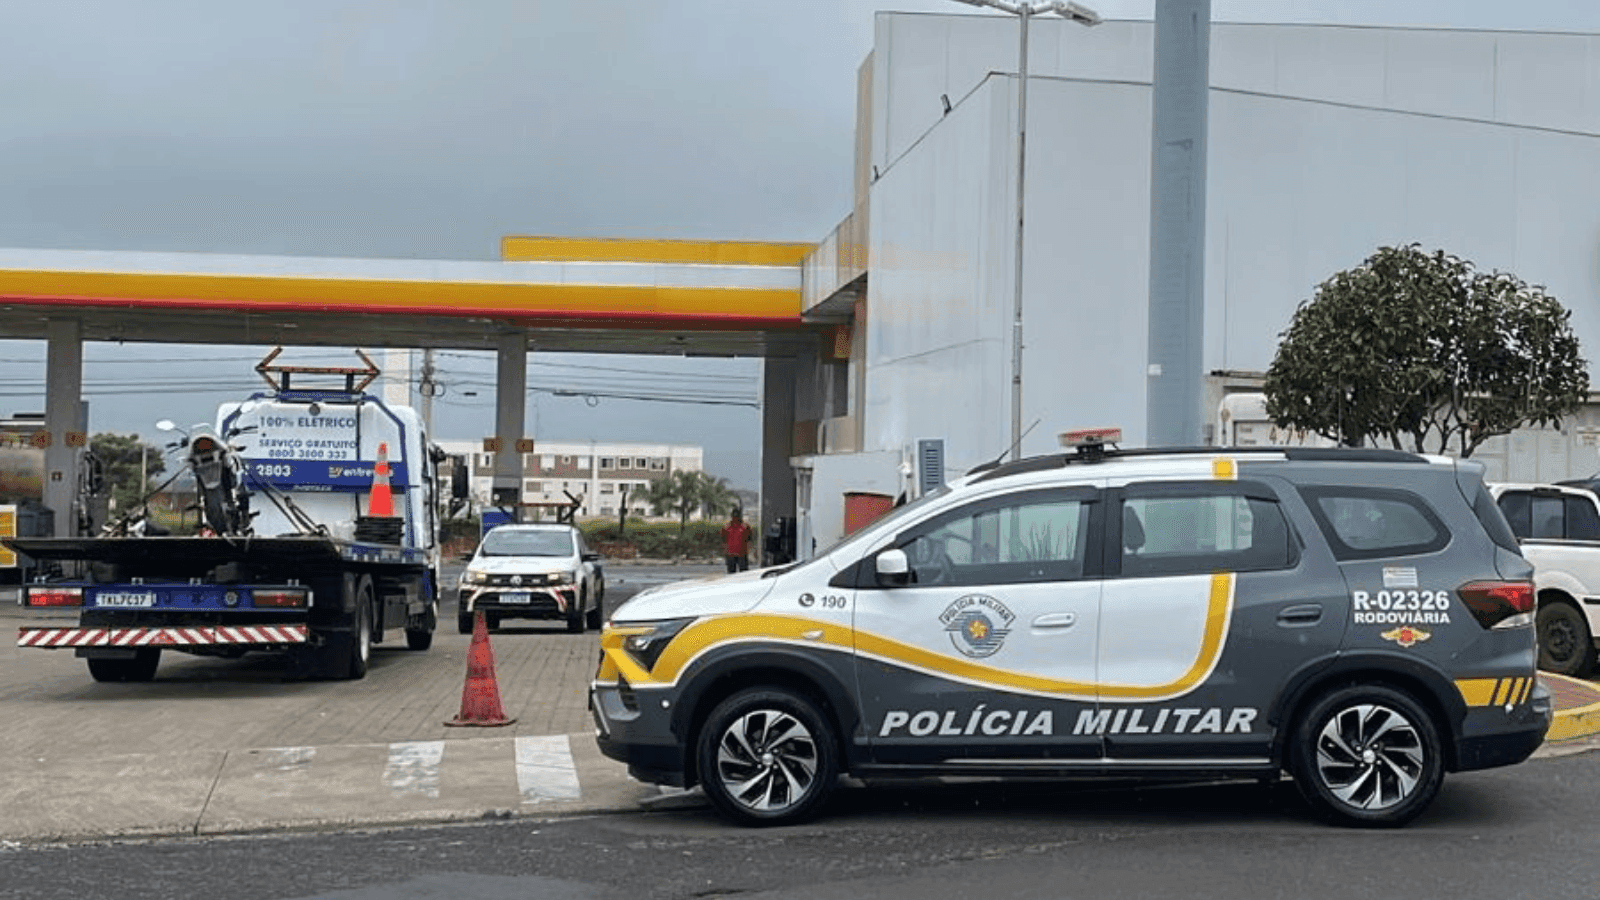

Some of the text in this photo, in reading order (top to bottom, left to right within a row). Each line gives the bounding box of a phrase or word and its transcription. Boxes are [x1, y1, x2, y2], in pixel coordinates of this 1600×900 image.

[260, 417, 294, 427] 100%
[306, 440, 357, 449] GRATUITO
[256, 464, 291, 477] 2803
[821, 595, 847, 609] 190
[1353, 590, 1450, 611] R-02326
[979, 598, 1011, 621] MILITAR
[1353, 610, 1450, 624] RODOVIÁRIA
[879, 704, 1258, 737] POLÍCIA MILITAR
